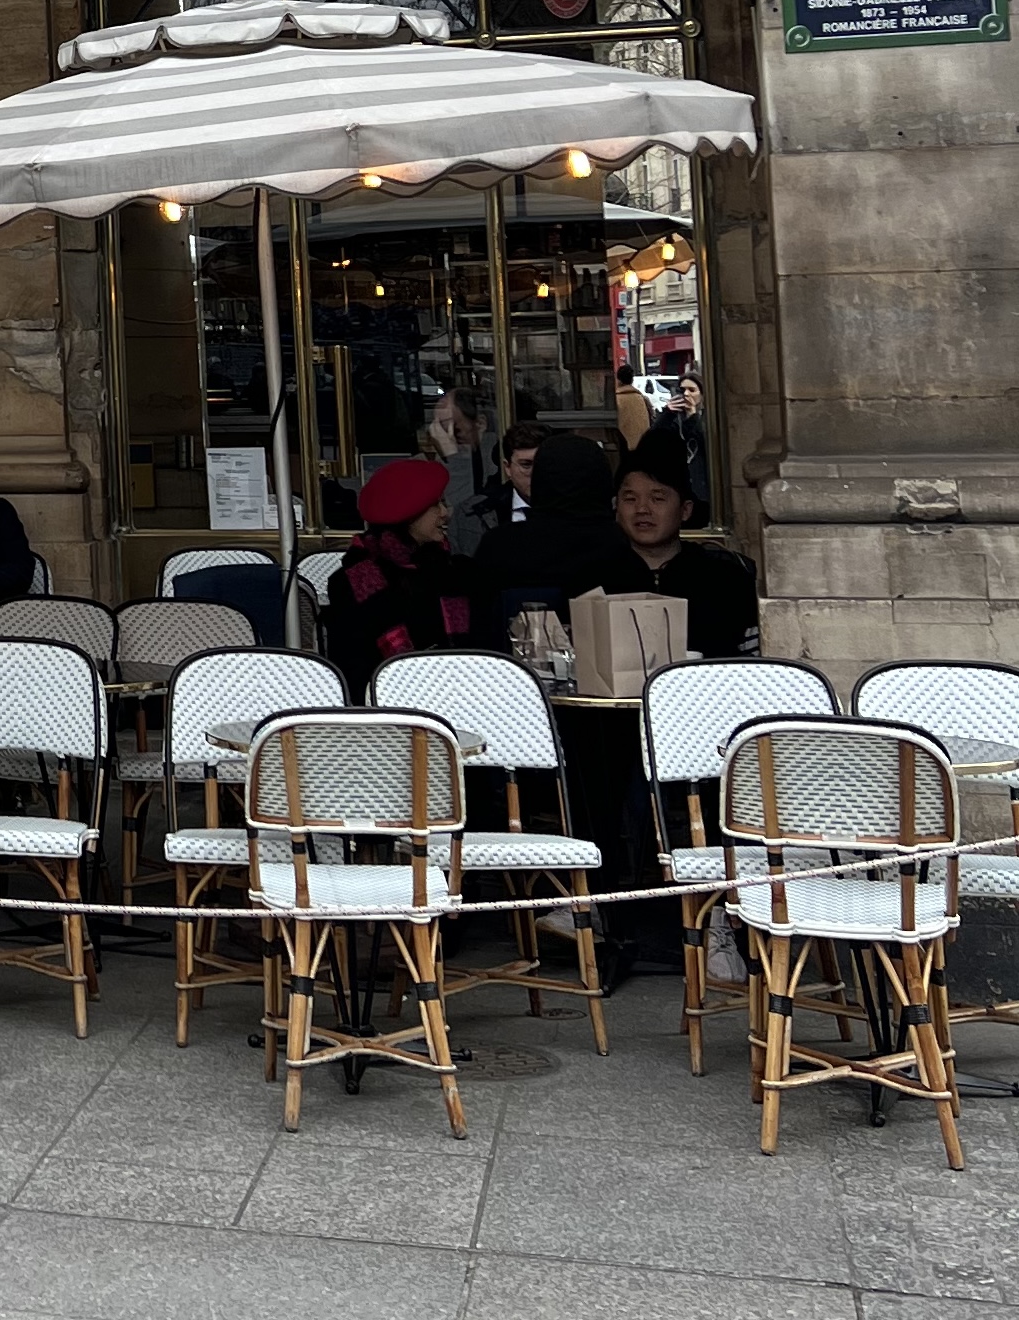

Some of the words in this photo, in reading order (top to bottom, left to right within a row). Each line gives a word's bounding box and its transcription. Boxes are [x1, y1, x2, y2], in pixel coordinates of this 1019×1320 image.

[860, 7, 886, 18] 1873
[902, 5, 928, 16] 1954
[822, 16, 898, 33] ROMANCIÈRE
[901, 14, 969, 30] FRANÇAISE
